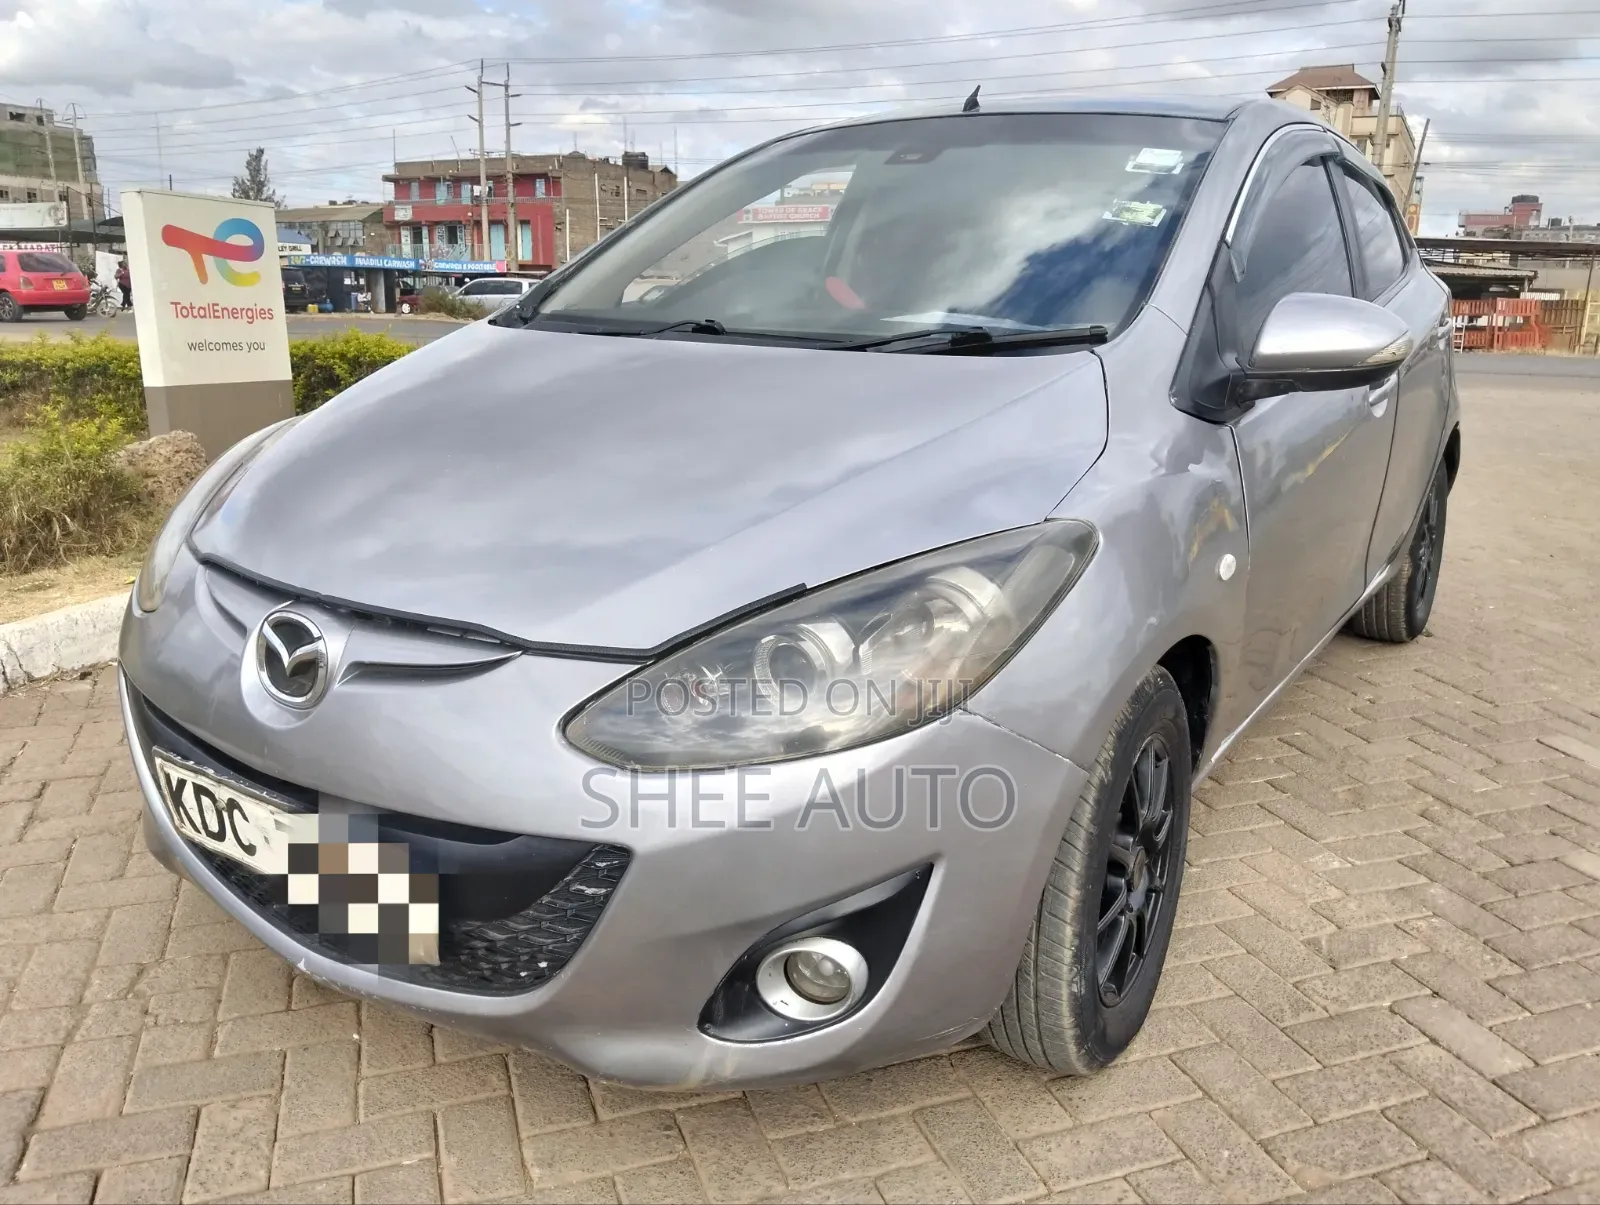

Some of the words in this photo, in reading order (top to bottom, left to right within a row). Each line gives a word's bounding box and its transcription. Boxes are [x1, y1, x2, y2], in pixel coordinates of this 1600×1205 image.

[355, 257, 382, 267] MAADILI
[383, 259, 415, 269] CARWASH
[434, 261, 462, 270] CARWASH
[170, 302, 274, 324] TotalEnergies
[187, 339, 243, 352] welcomes
[247, 341, 266, 353] you
[163, 770, 257, 857] KDC
